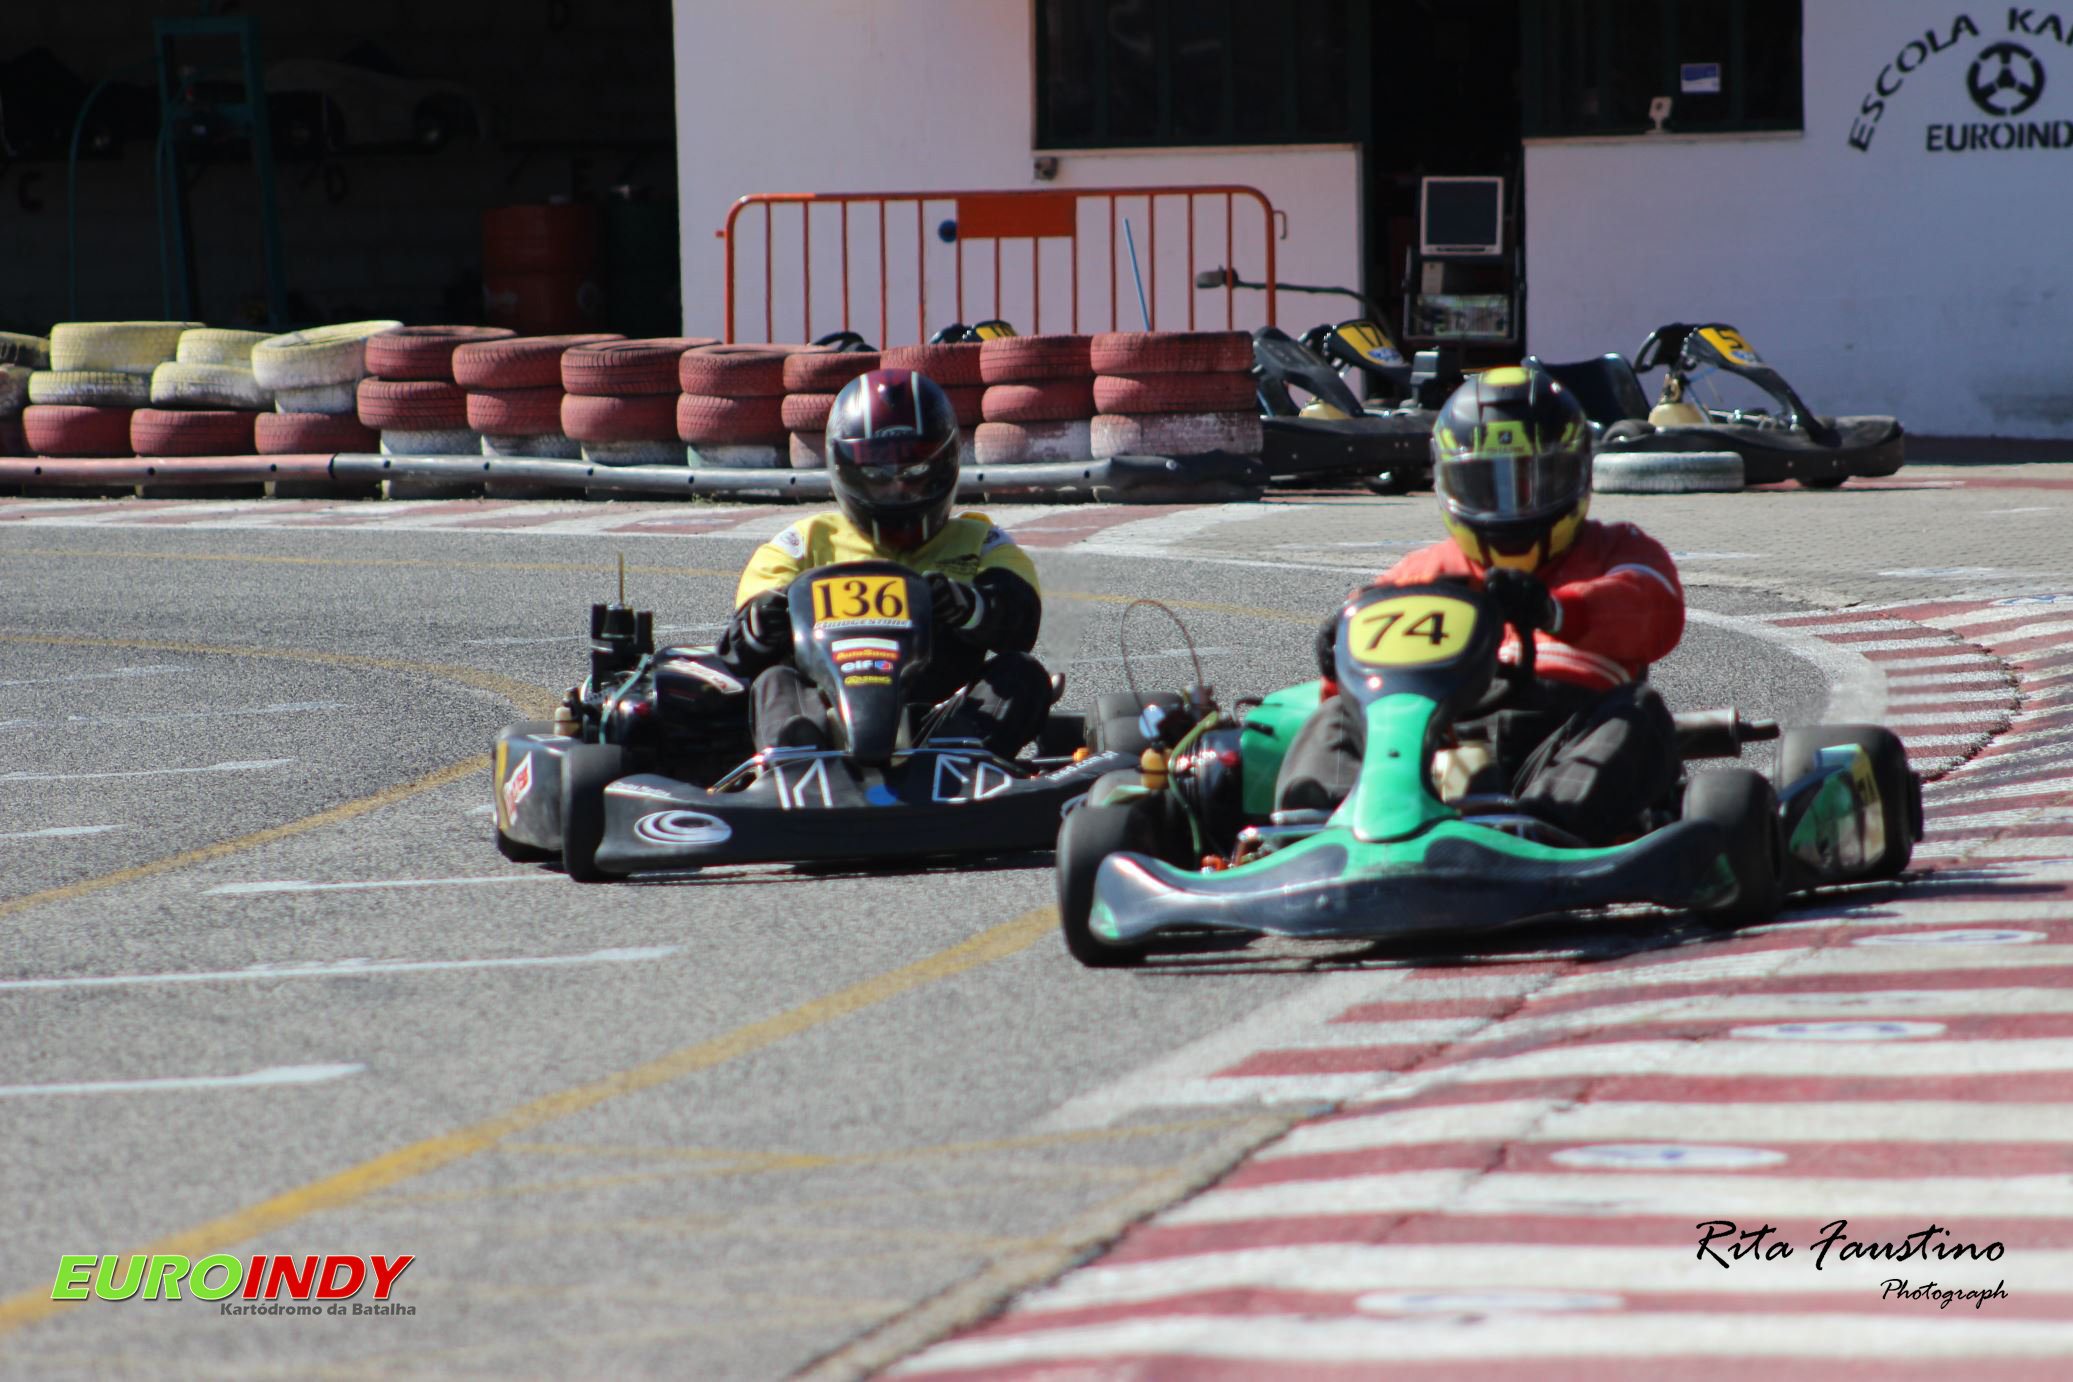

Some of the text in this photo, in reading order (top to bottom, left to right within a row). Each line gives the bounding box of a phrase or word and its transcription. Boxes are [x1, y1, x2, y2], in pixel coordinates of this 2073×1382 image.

[1848, 7, 2073, 151] ESCOLA KA
[1926, 119, 2073, 151] EUROIND
[816, 580, 903, 621] 136
[1362, 610, 1449, 651] 74
